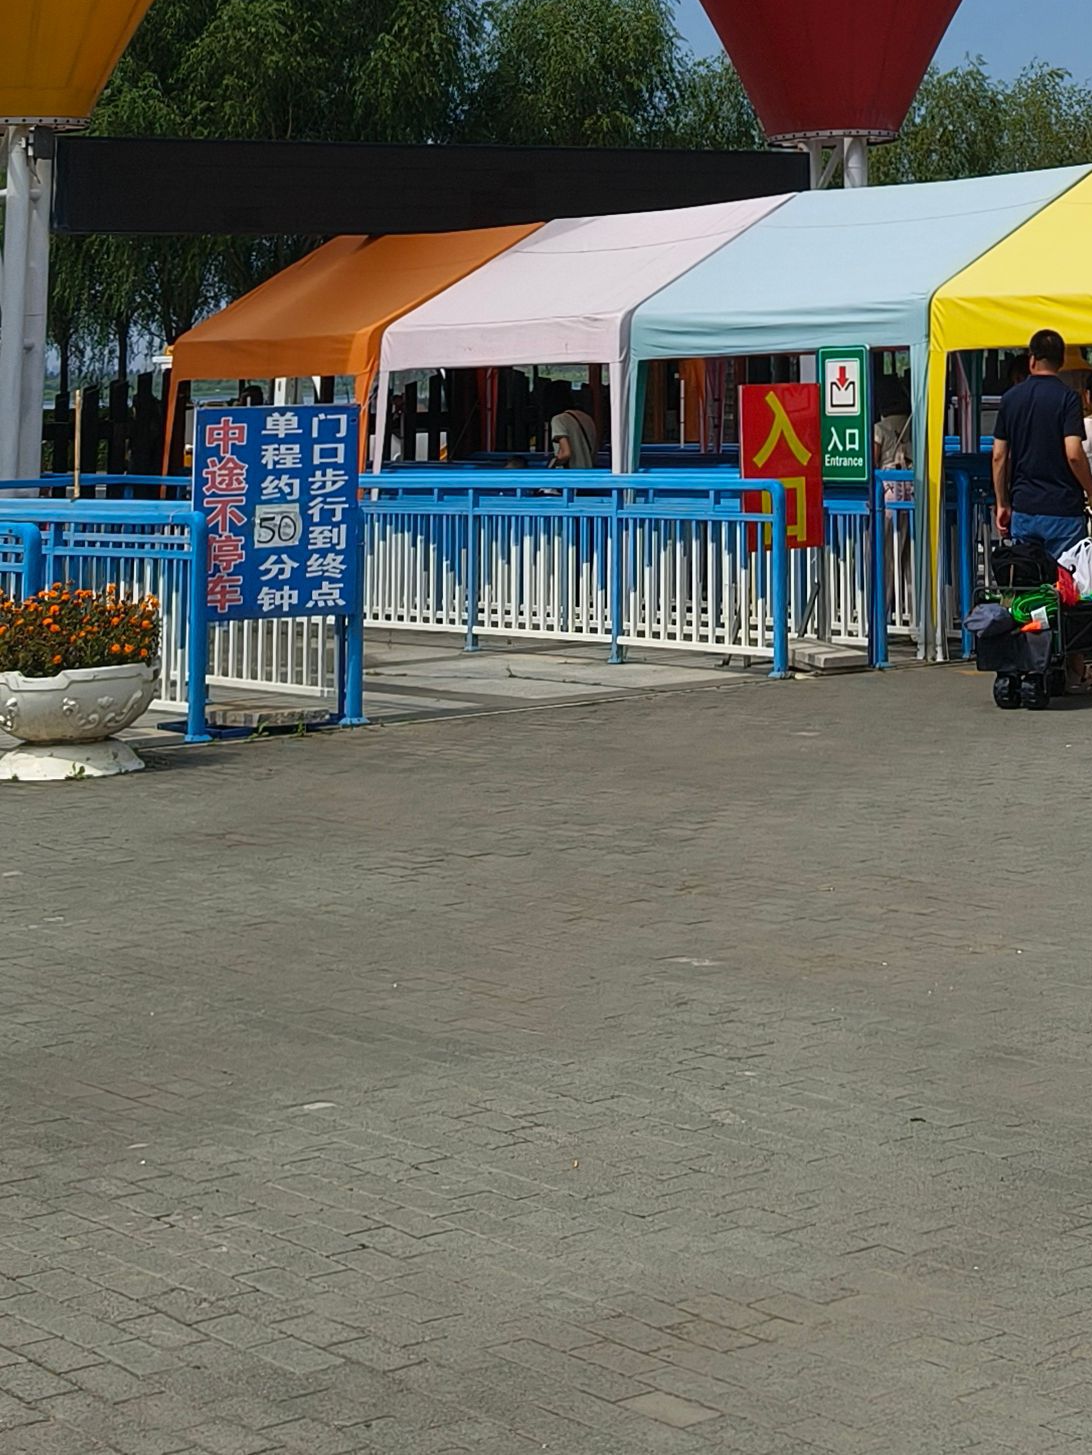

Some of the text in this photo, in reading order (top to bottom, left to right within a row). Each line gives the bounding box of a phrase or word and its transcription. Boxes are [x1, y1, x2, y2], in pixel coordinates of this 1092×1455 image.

[203, 416, 248, 613] 中途不停车
[306, 412, 349, 608] 门口步行到终点
[753, 391, 812, 544] 入口
[825, 454, 864, 467] Entrance
[828, 426, 859, 451] 入口
